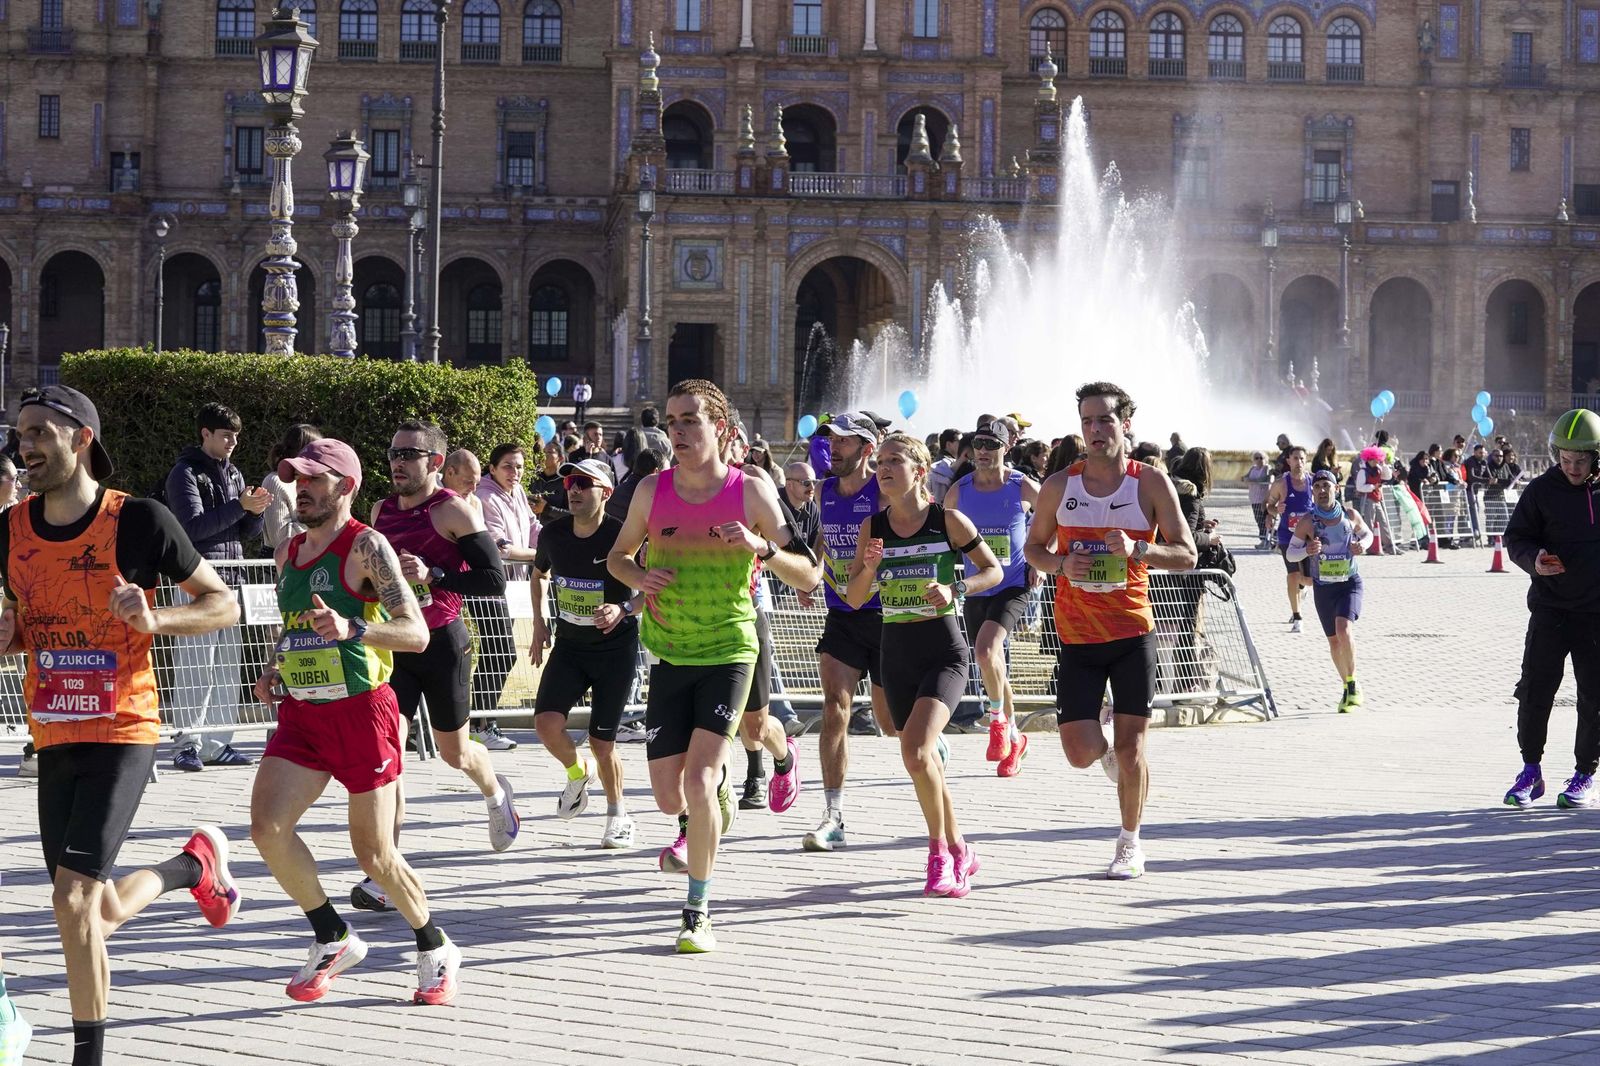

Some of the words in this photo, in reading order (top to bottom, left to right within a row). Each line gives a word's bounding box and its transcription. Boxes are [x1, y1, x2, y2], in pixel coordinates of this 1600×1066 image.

[896, 567, 930, 576] ZURICH
[1089, 570, 1107, 581] TIM
[569, 580, 598, 589] ZURICH
[899, 584, 917, 592] 1759
[570, 594, 585, 602] 1589
[294, 636, 328, 647] ZURICH
[58, 654, 105, 665] ZURICH
[298, 656, 316, 667] 3090
[290, 669, 331, 686] RUBEN
[62, 678, 84, 690] 1029
[46, 694, 100, 712] JAVIER
